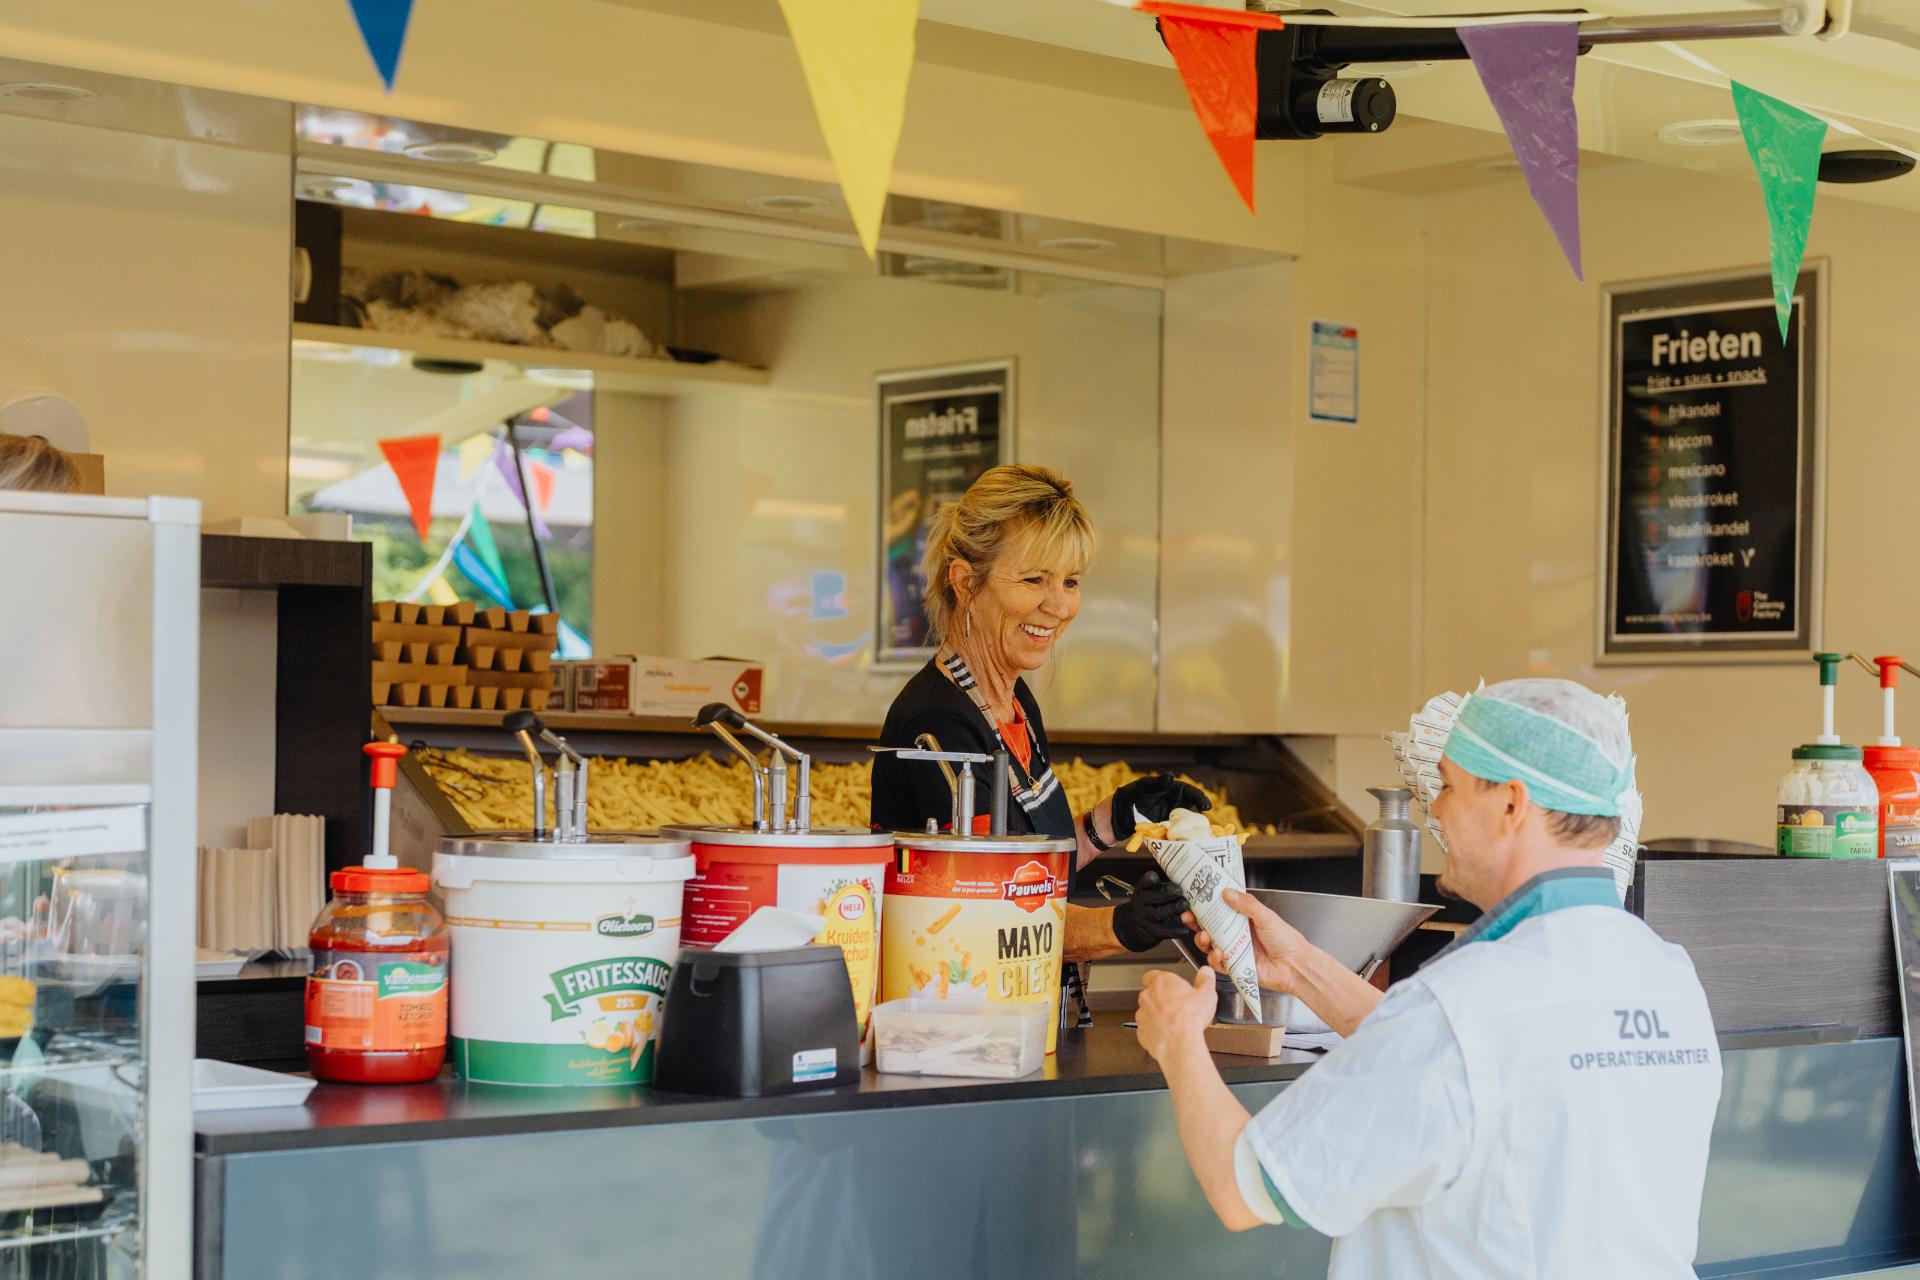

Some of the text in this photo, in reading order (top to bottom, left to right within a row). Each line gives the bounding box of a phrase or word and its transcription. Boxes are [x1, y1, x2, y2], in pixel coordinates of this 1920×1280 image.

[1652, 329, 1762, 366] Frieten
[1727, 366, 1767, 381] snack
[1669, 402, 1721, 419] frikandel
[1668, 434, 1713, 449] kipcorn
[1668, 463, 1726, 479] mexicano
[1668, 491, 1739, 508] vleeskroket
[1667, 552, 1735, 568] kaaskroket
[1008, 880, 1052, 897] Pauwels
[998, 922, 1053, 960] MAYO
[998, 962, 1051, 998] CHEF
[616, 998, 636, 1009] 25%
[1614, 1008, 1670, 1039] ZOL
[1570, 1048, 1710, 1070] OPERATIEKWARTIER
